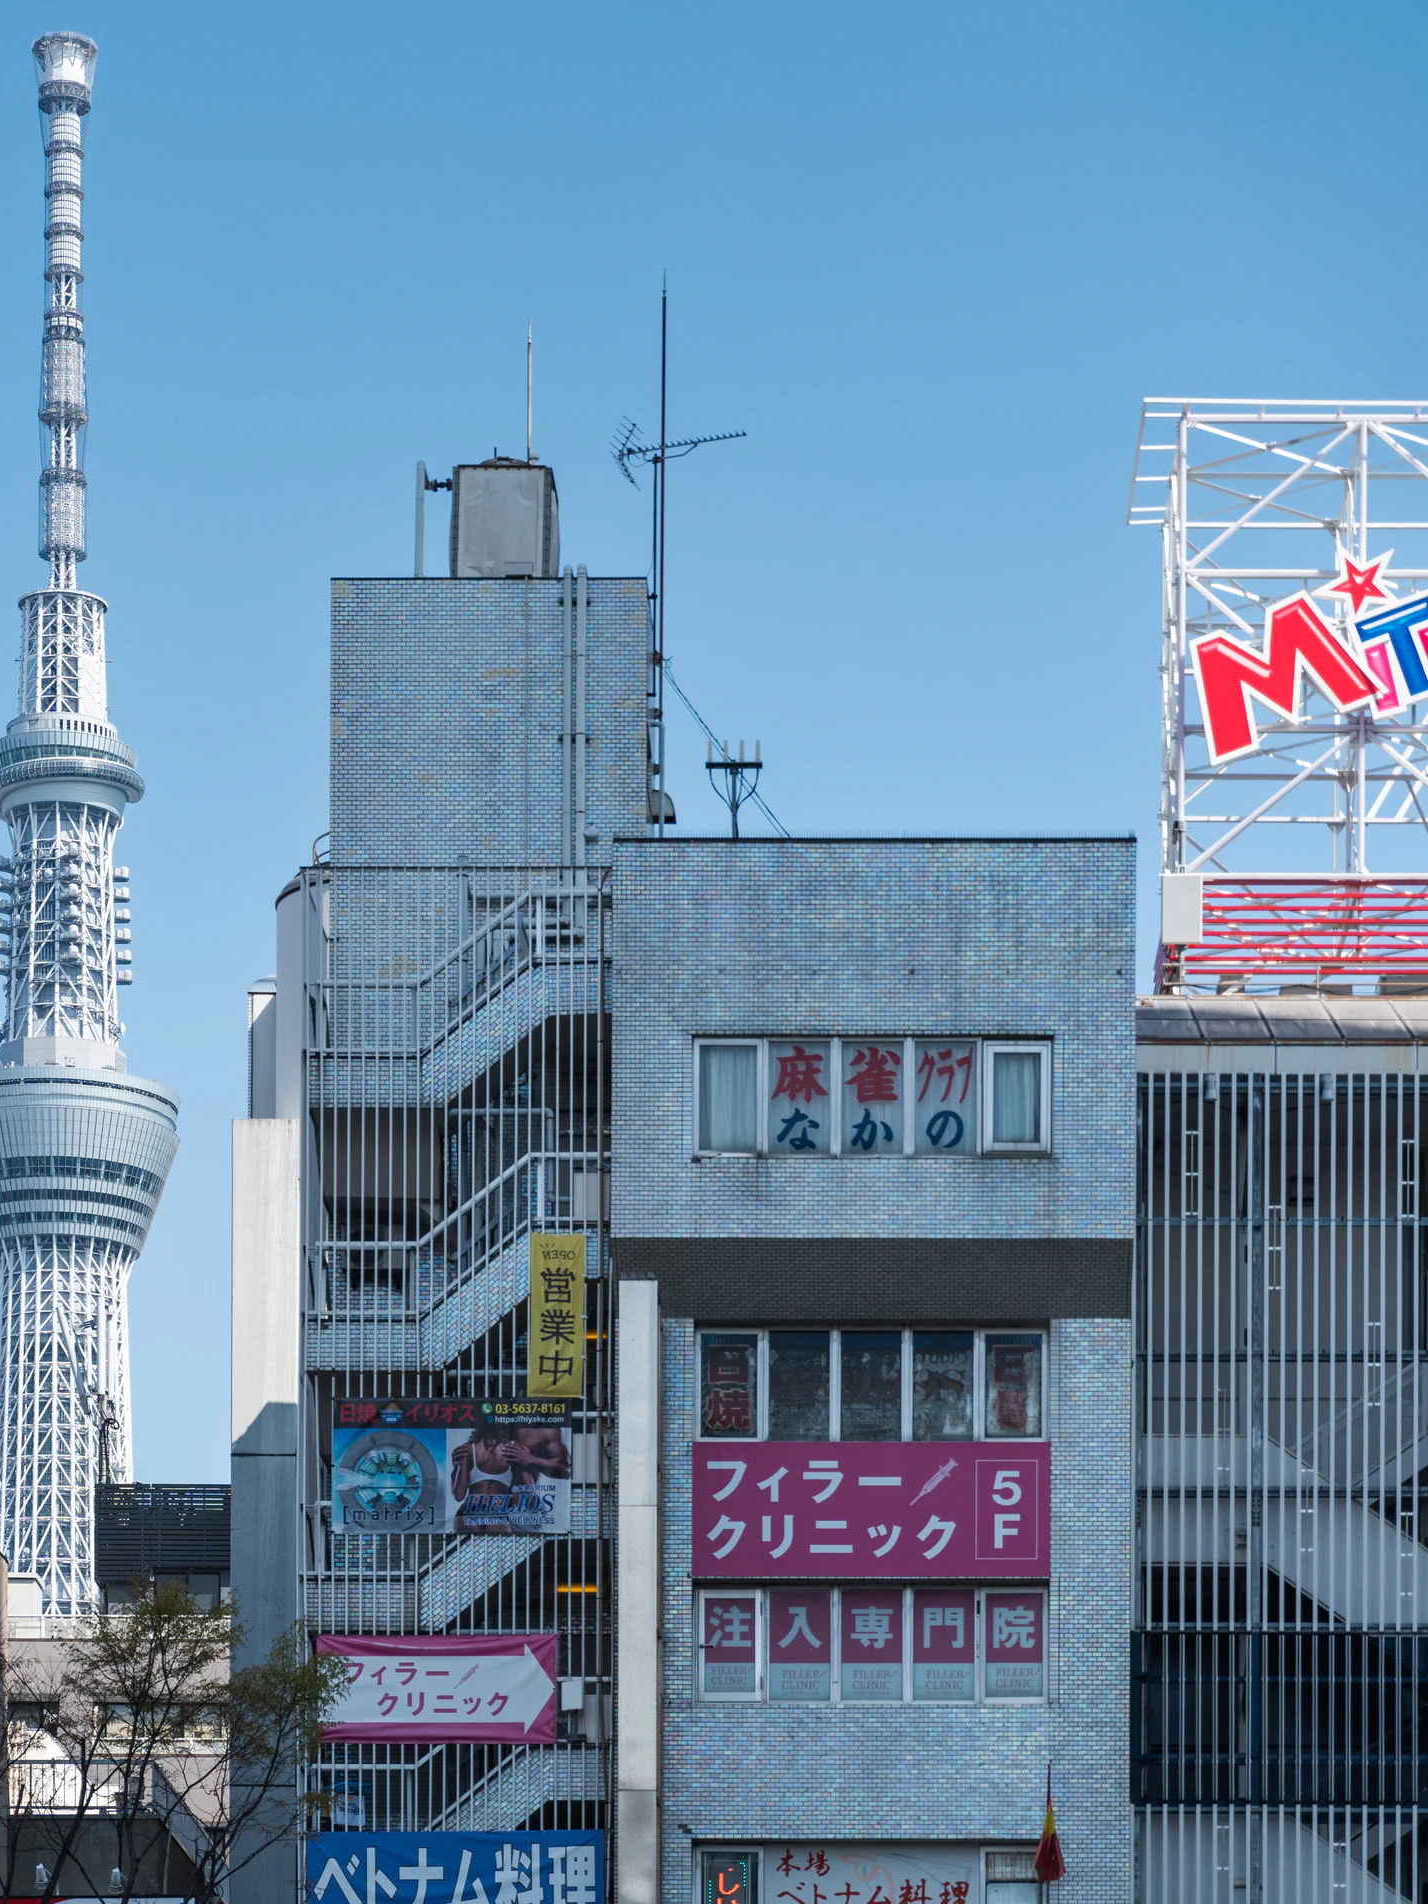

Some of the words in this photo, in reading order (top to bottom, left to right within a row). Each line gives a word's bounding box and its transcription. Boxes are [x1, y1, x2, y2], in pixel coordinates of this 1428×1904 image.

[776, 1108, 965, 1150] なかの
[339, 1403, 377, 1423] 日焼
[404, 1403, 477, 1423] イリオス
[495, 1403, 566, 1414] 03-5637-8161
[494, 1415, 565, 1425] https://hiyake.com
[706, 1460, 902, 1503] フィラー
[511, 1484, 556, 1493] SOLARIUM
[465, 1492, 556, 1514] HELIOS
[463, 1517, 502, 1526] TANNING
[509, 1516, 556, 1526] WELLNESS
[706, 1514, 957, 1560] クリニック
[708, 1605, 1036, 1649] 注入専門院
[342, 1661, 450, 1687] フィラー
[711, 1666, 747, 1674] FILLER
[782, 1670, 820, 1678] FILLER
[853, 1670, 891, 1678] FILLER
[926, 1670, 964, 1678] FILLER
[996, 1668, 1034, 1677] FILLER
[711, 1676, 747, 1685] CLINIC
[782, 1681, 820, 1690] CLINIC
[853, 1681, 891, 1690] CLINIC
[926, 1681, 964, 1690] CLINIC
[996, 1679, 1034, 1688] CLINIC
[376, 1691, 509, 1717] クリニック
[776, 1849, 831, 1878] 本場
